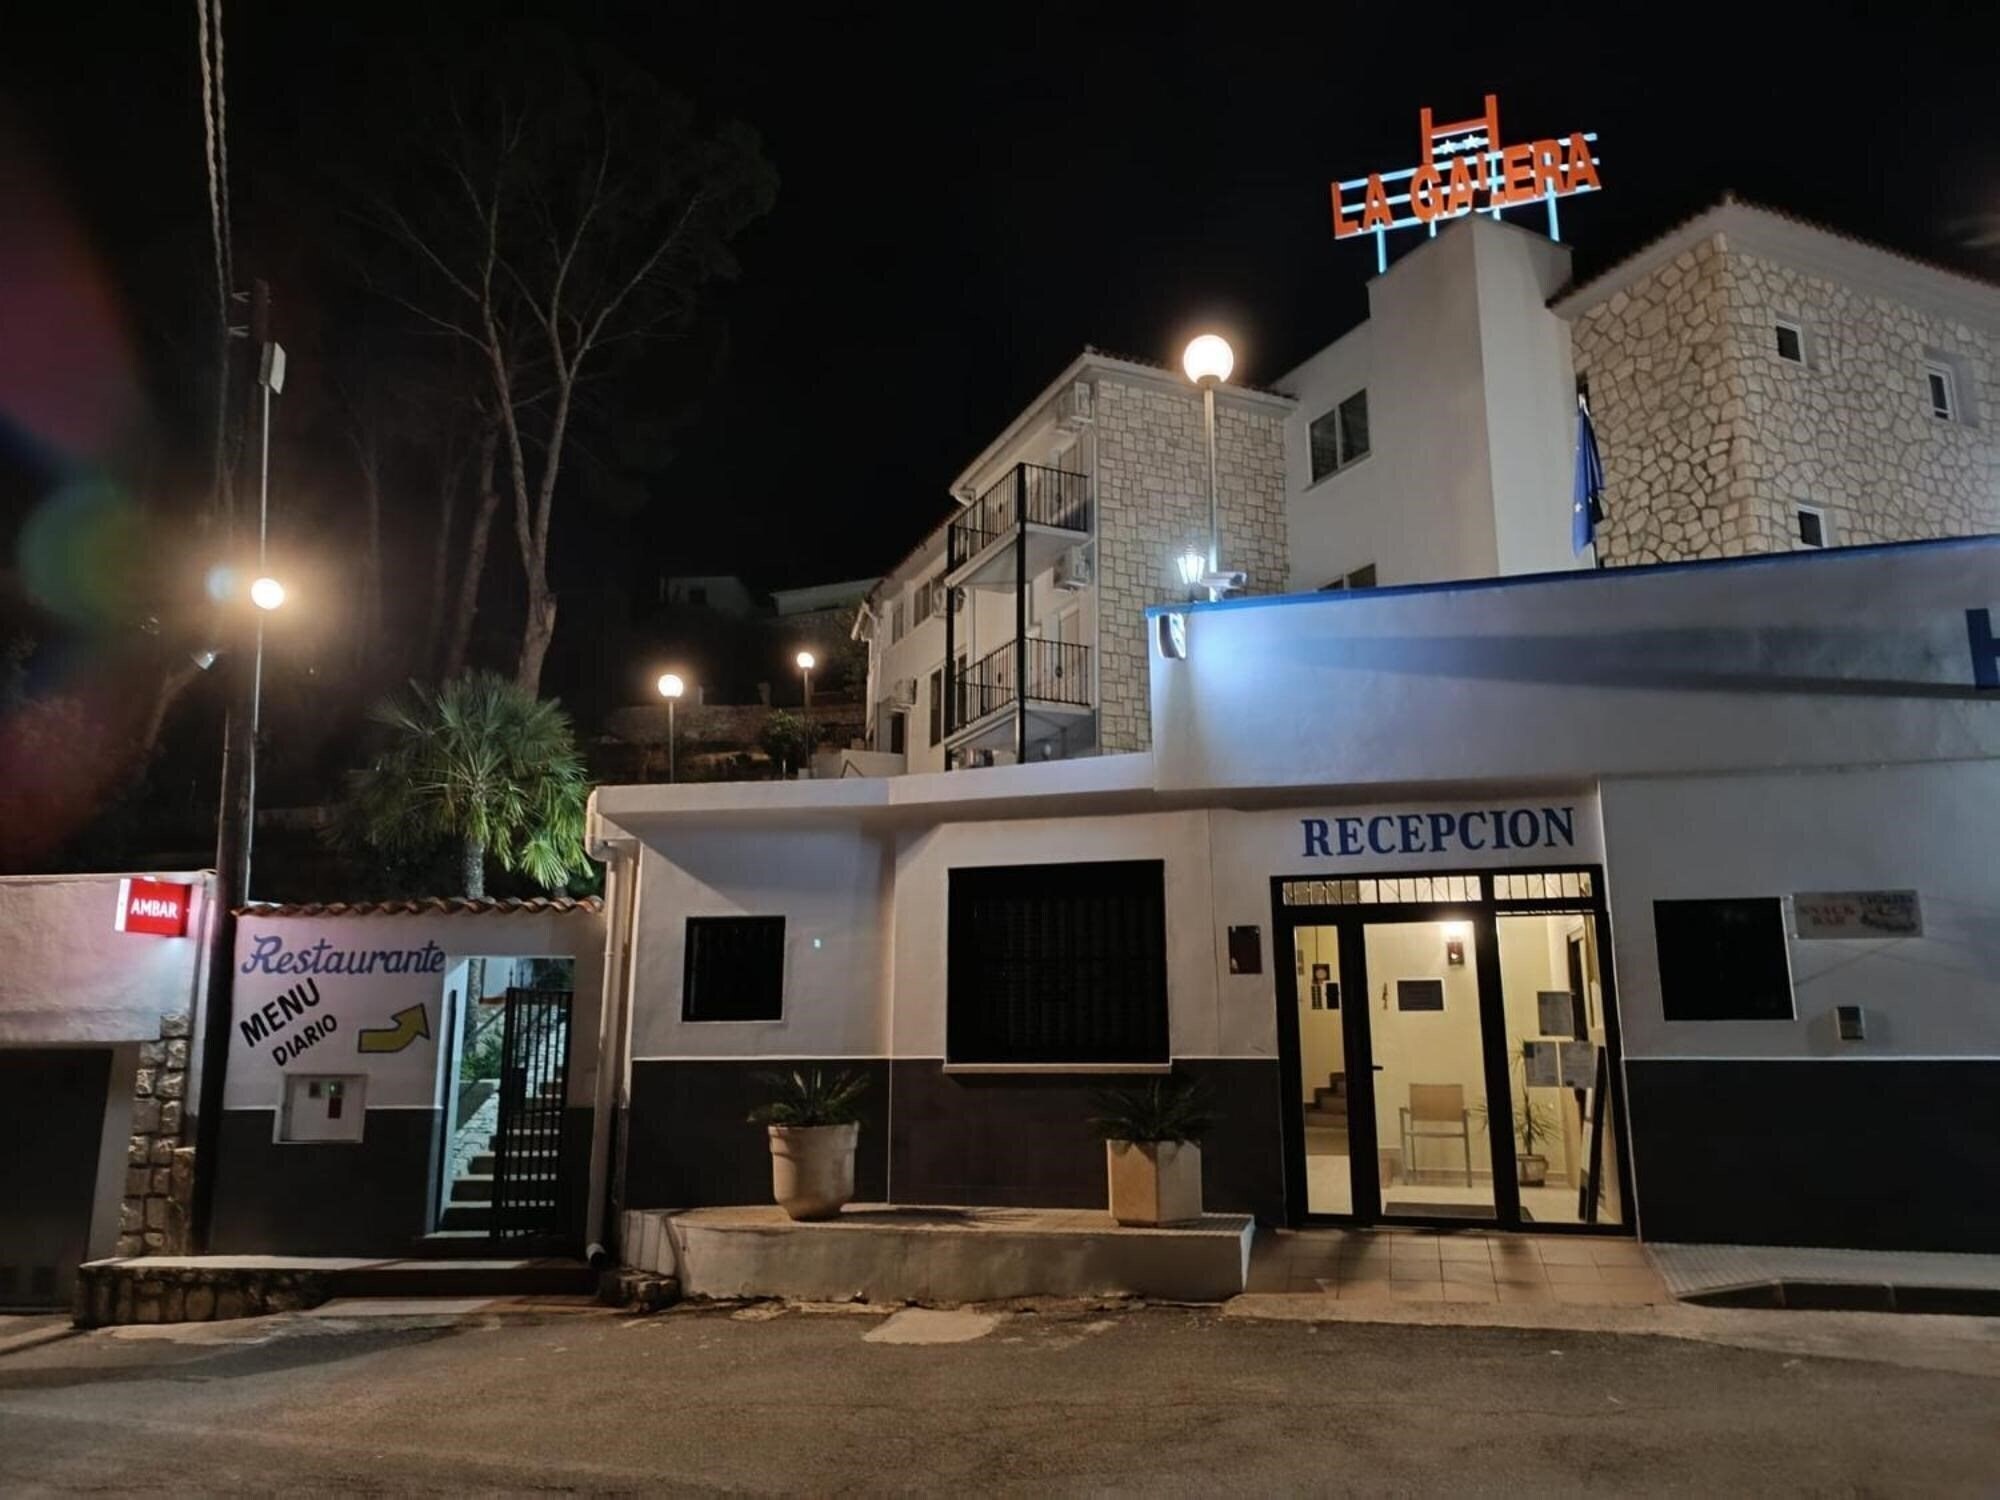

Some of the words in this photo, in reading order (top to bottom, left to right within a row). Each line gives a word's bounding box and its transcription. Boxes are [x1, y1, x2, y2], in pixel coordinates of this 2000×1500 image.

[1331, 174, 1393, 238] LA
[1410, 132, 1602, 222] GALERA
[1302, 807, 1574, 857] RECEPCION
[130, 898, 178, 919] AMBAR
[241, 935, 446, 975] Restaurante
[240, 977, 321, 1048] MENU
[272, 1014, 337, 1067] DIARIO
